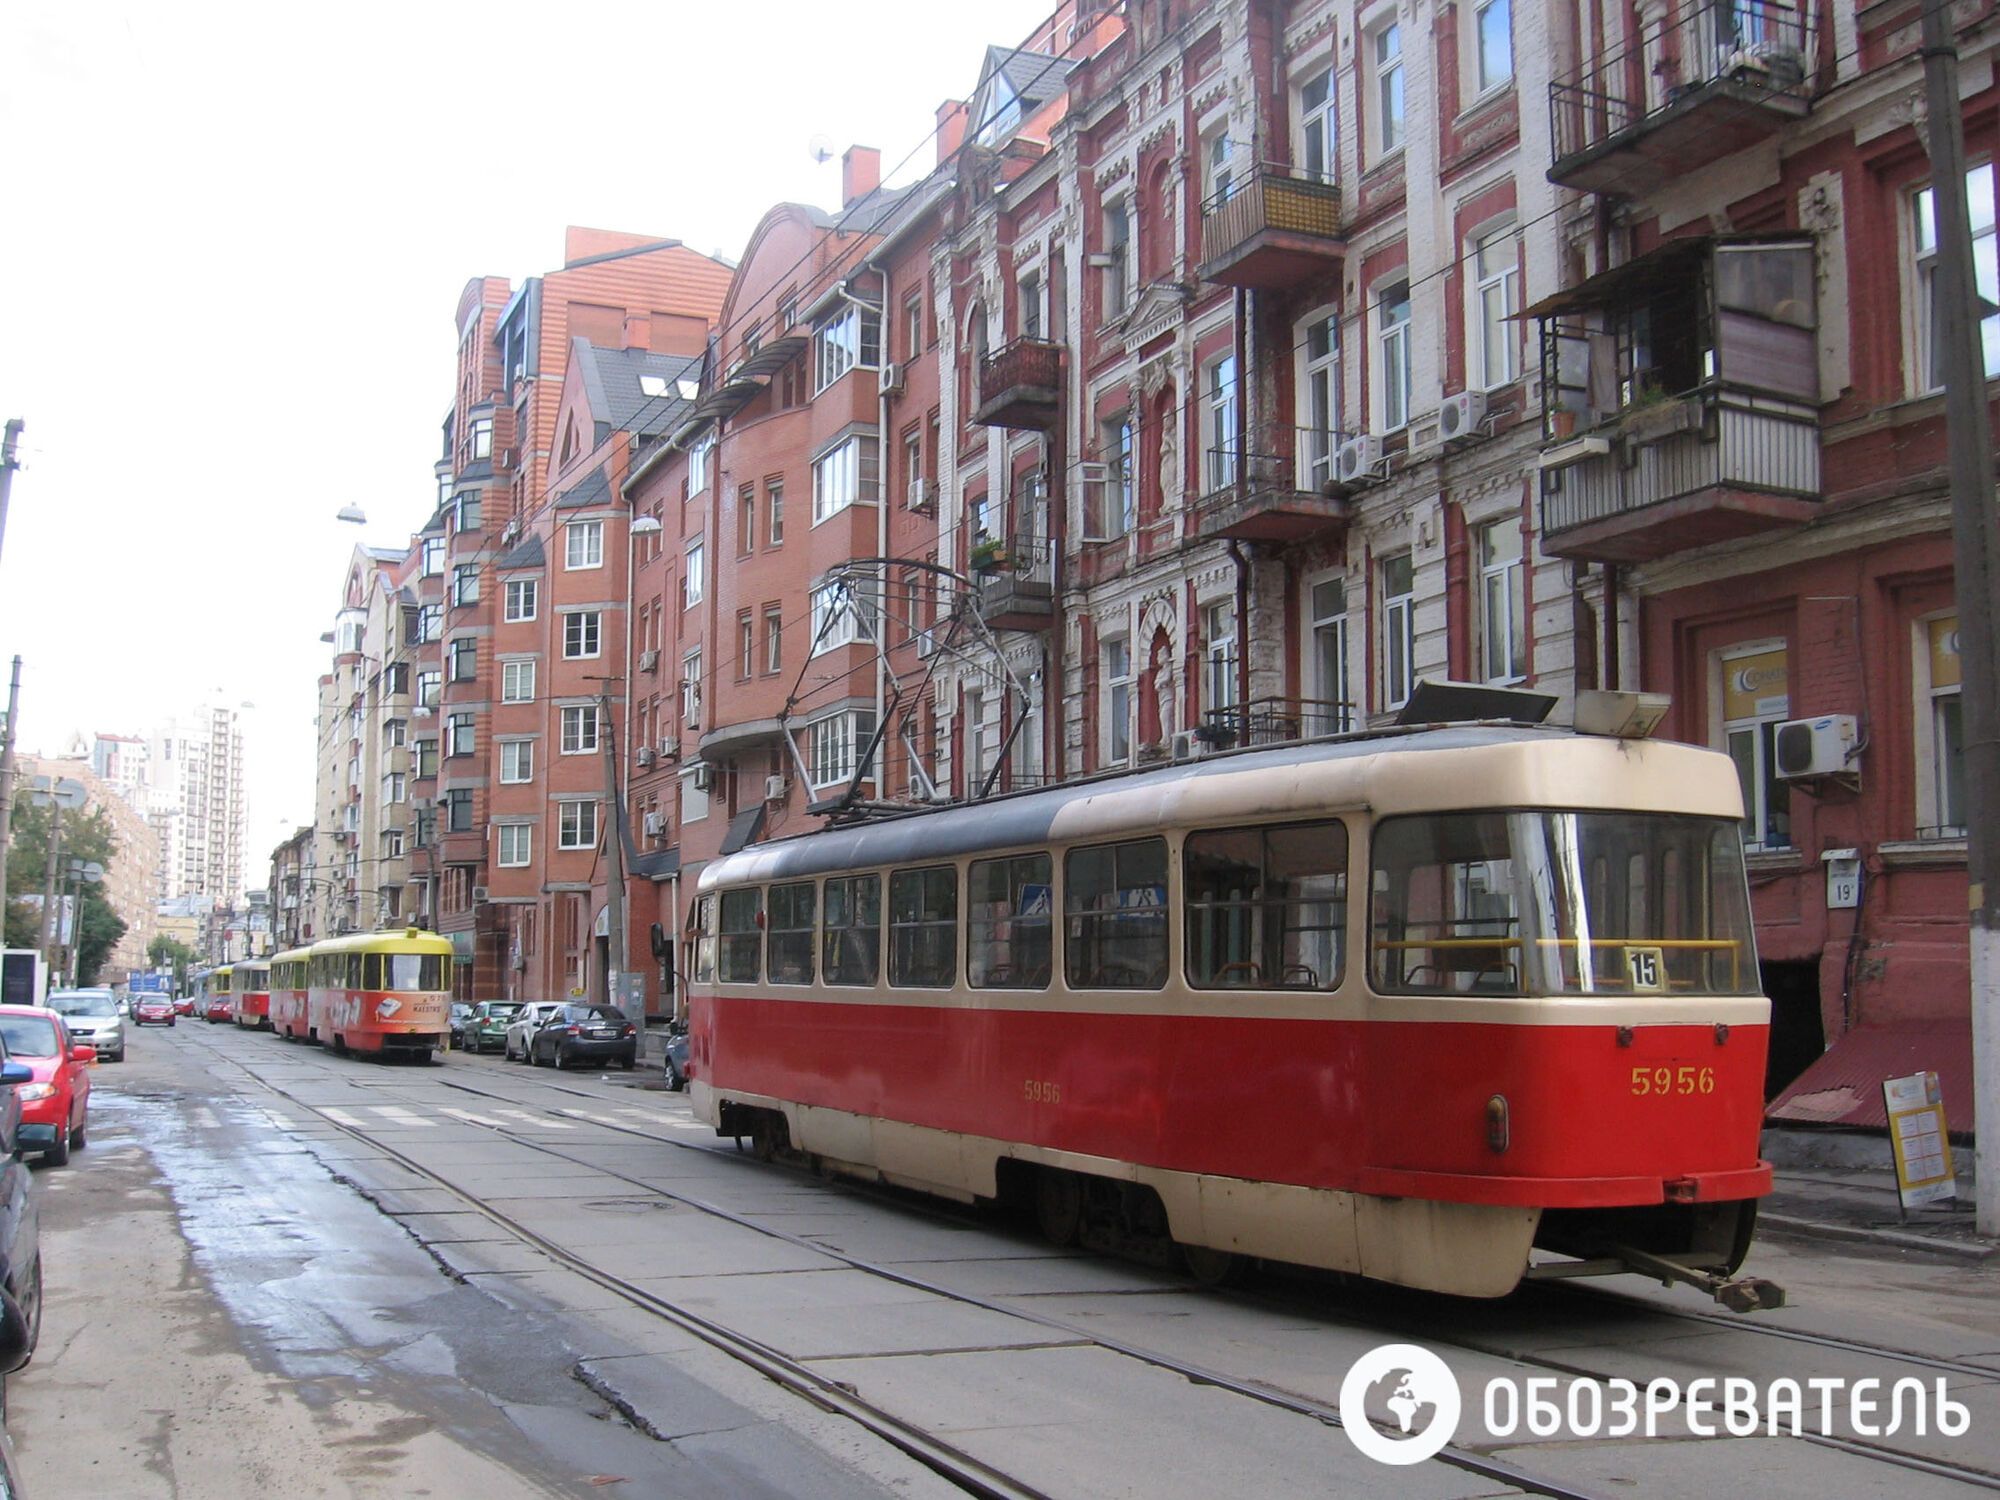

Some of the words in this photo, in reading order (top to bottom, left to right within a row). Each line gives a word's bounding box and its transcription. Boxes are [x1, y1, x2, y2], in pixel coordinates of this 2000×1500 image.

[1631, 953, 1657, 986] 15
[1024, 1079, 1061, 1104] 5956
[1631, 1066, 1715, 1095] 5956
